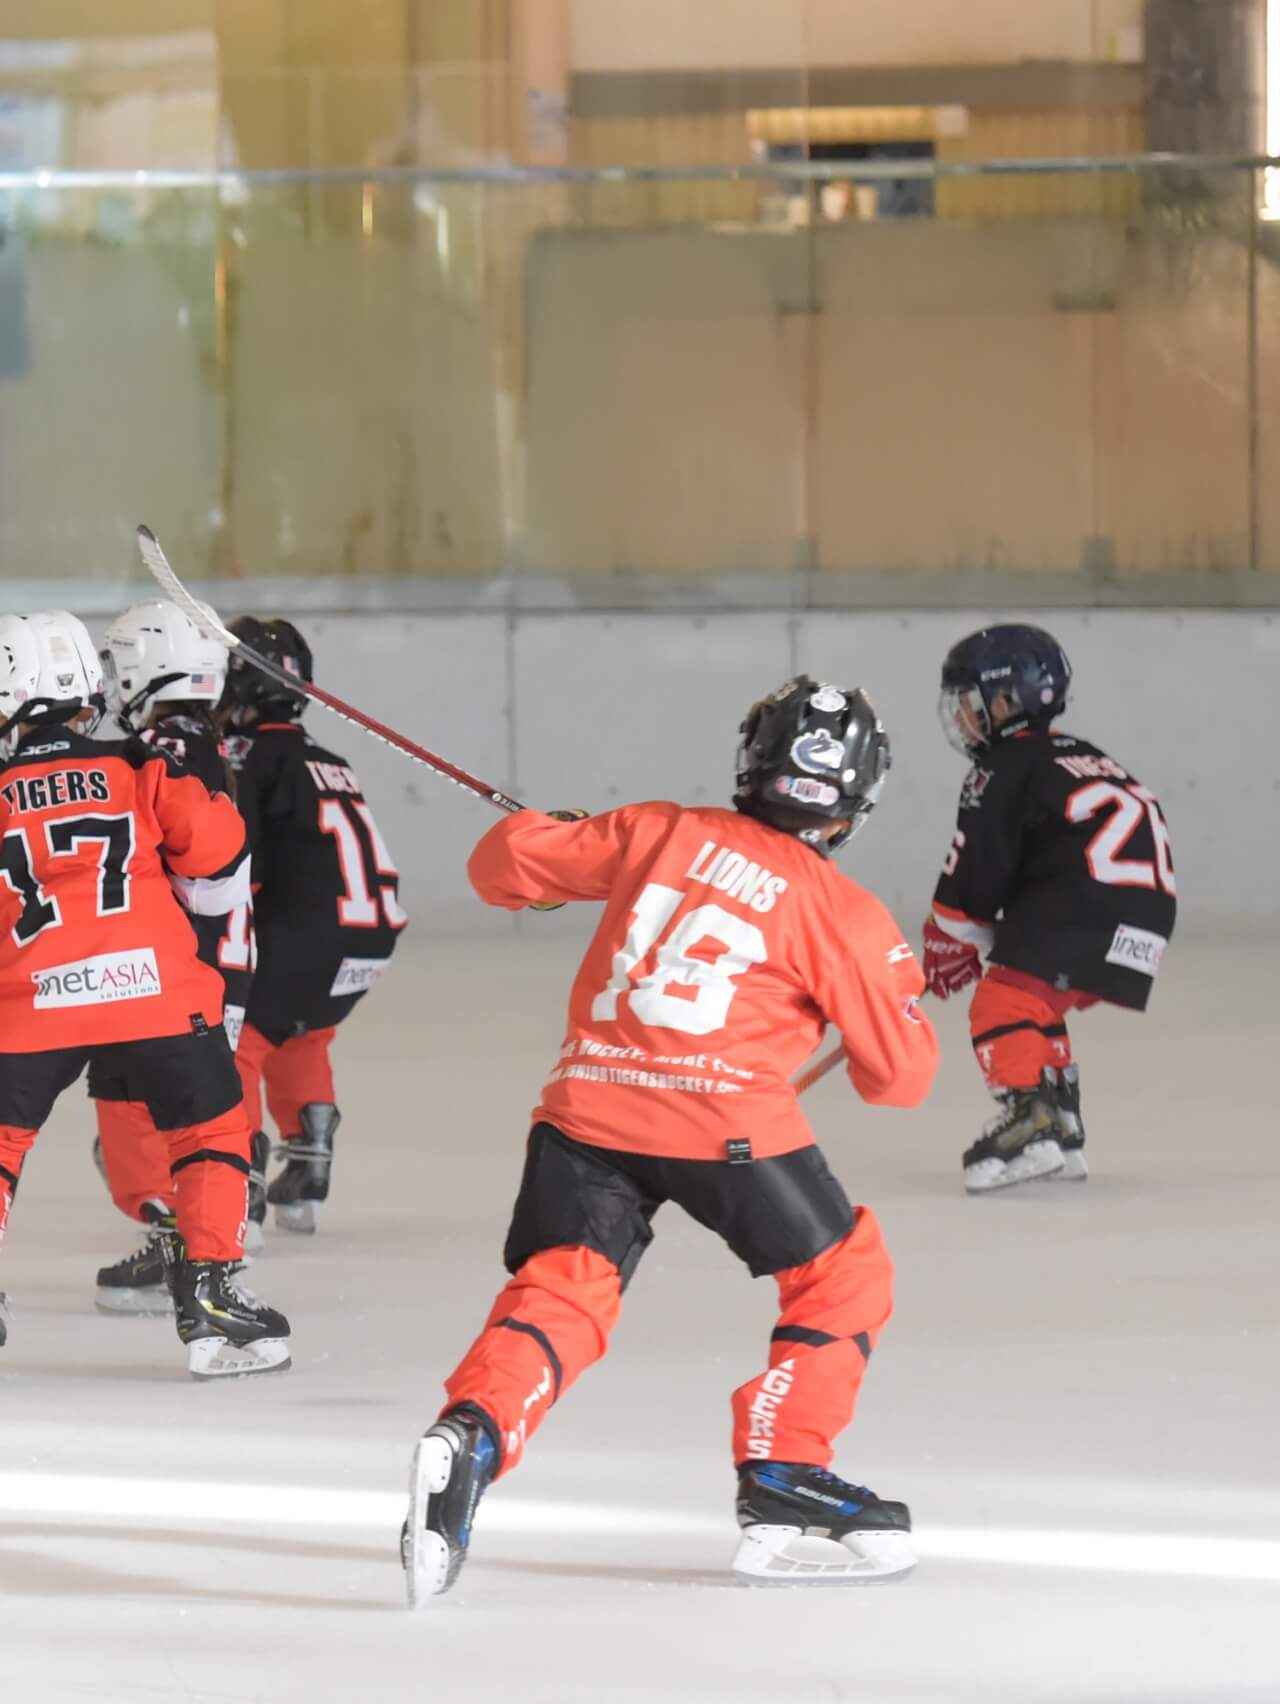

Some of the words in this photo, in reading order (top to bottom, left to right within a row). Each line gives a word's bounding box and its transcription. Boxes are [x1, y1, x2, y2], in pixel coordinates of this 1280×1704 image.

[0, 769, 110, 816] TIGERS
[685, 839, 788, 914] LIONS
[590, 882, 769, 1036] 18
[99, 985, 159, 1000] solutions
